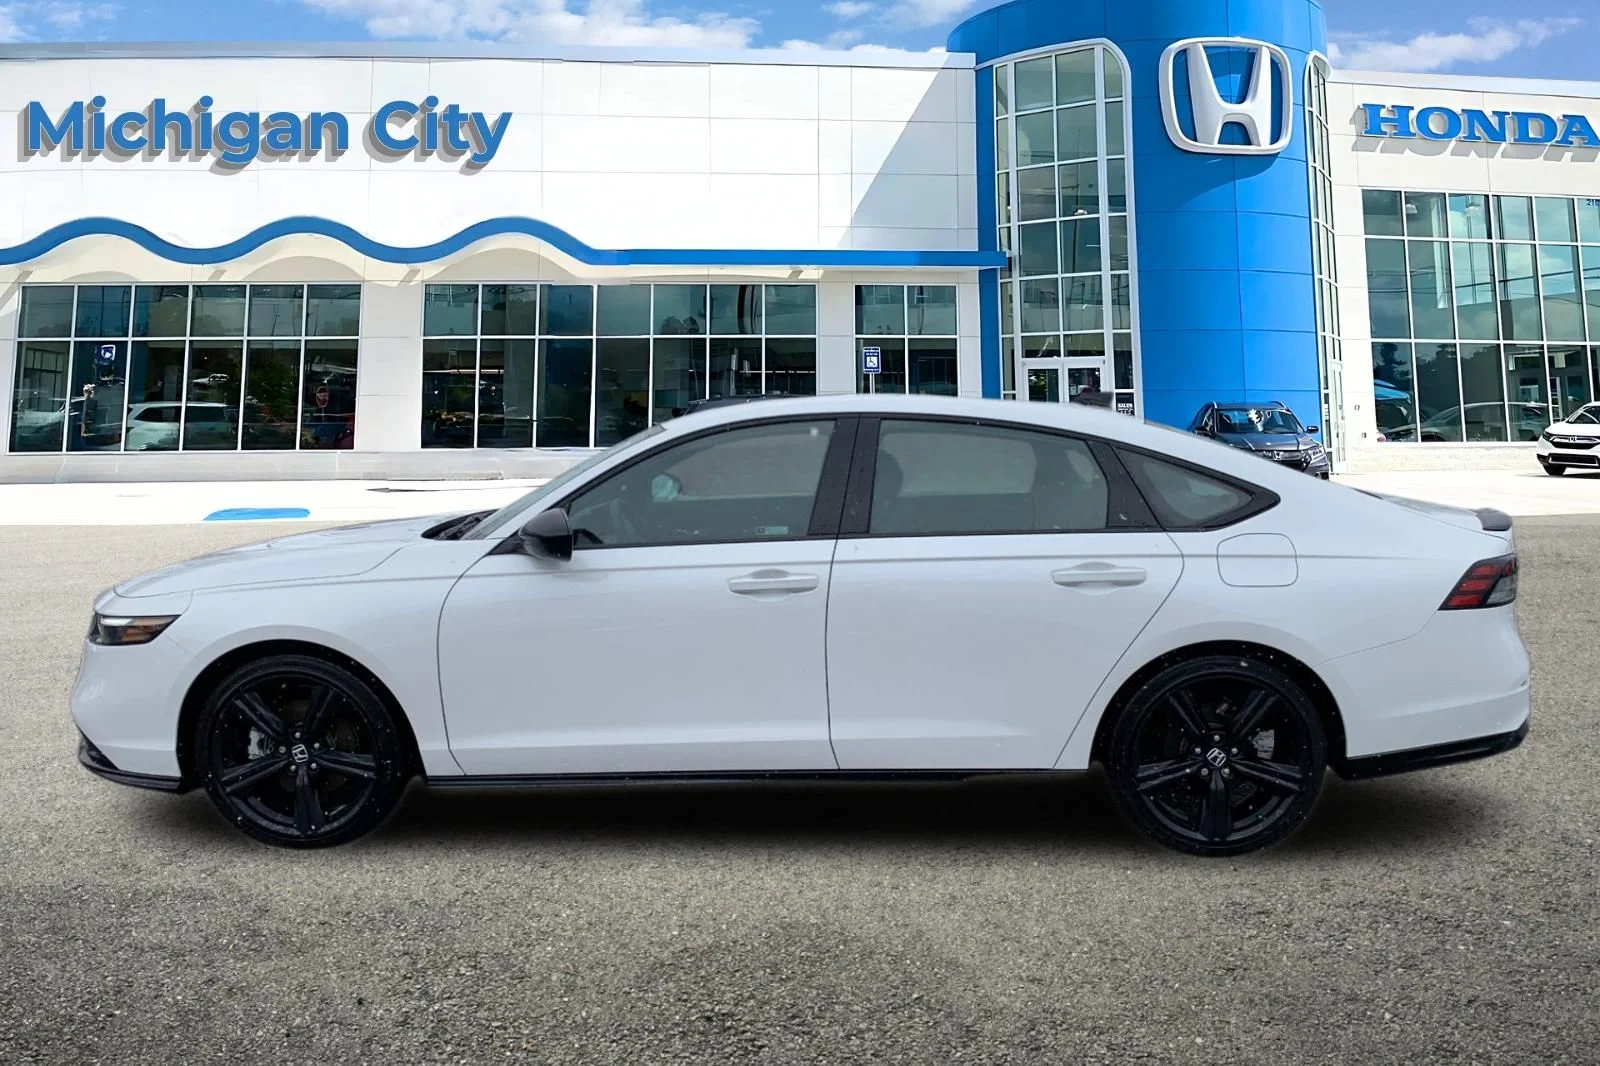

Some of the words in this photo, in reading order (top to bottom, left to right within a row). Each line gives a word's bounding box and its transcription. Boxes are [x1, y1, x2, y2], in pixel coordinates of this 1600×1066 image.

[27, 95, 350, 164] Michigan
[372, 95, 514, 164] City
[1361, 103, 1600, 148] HONDA
